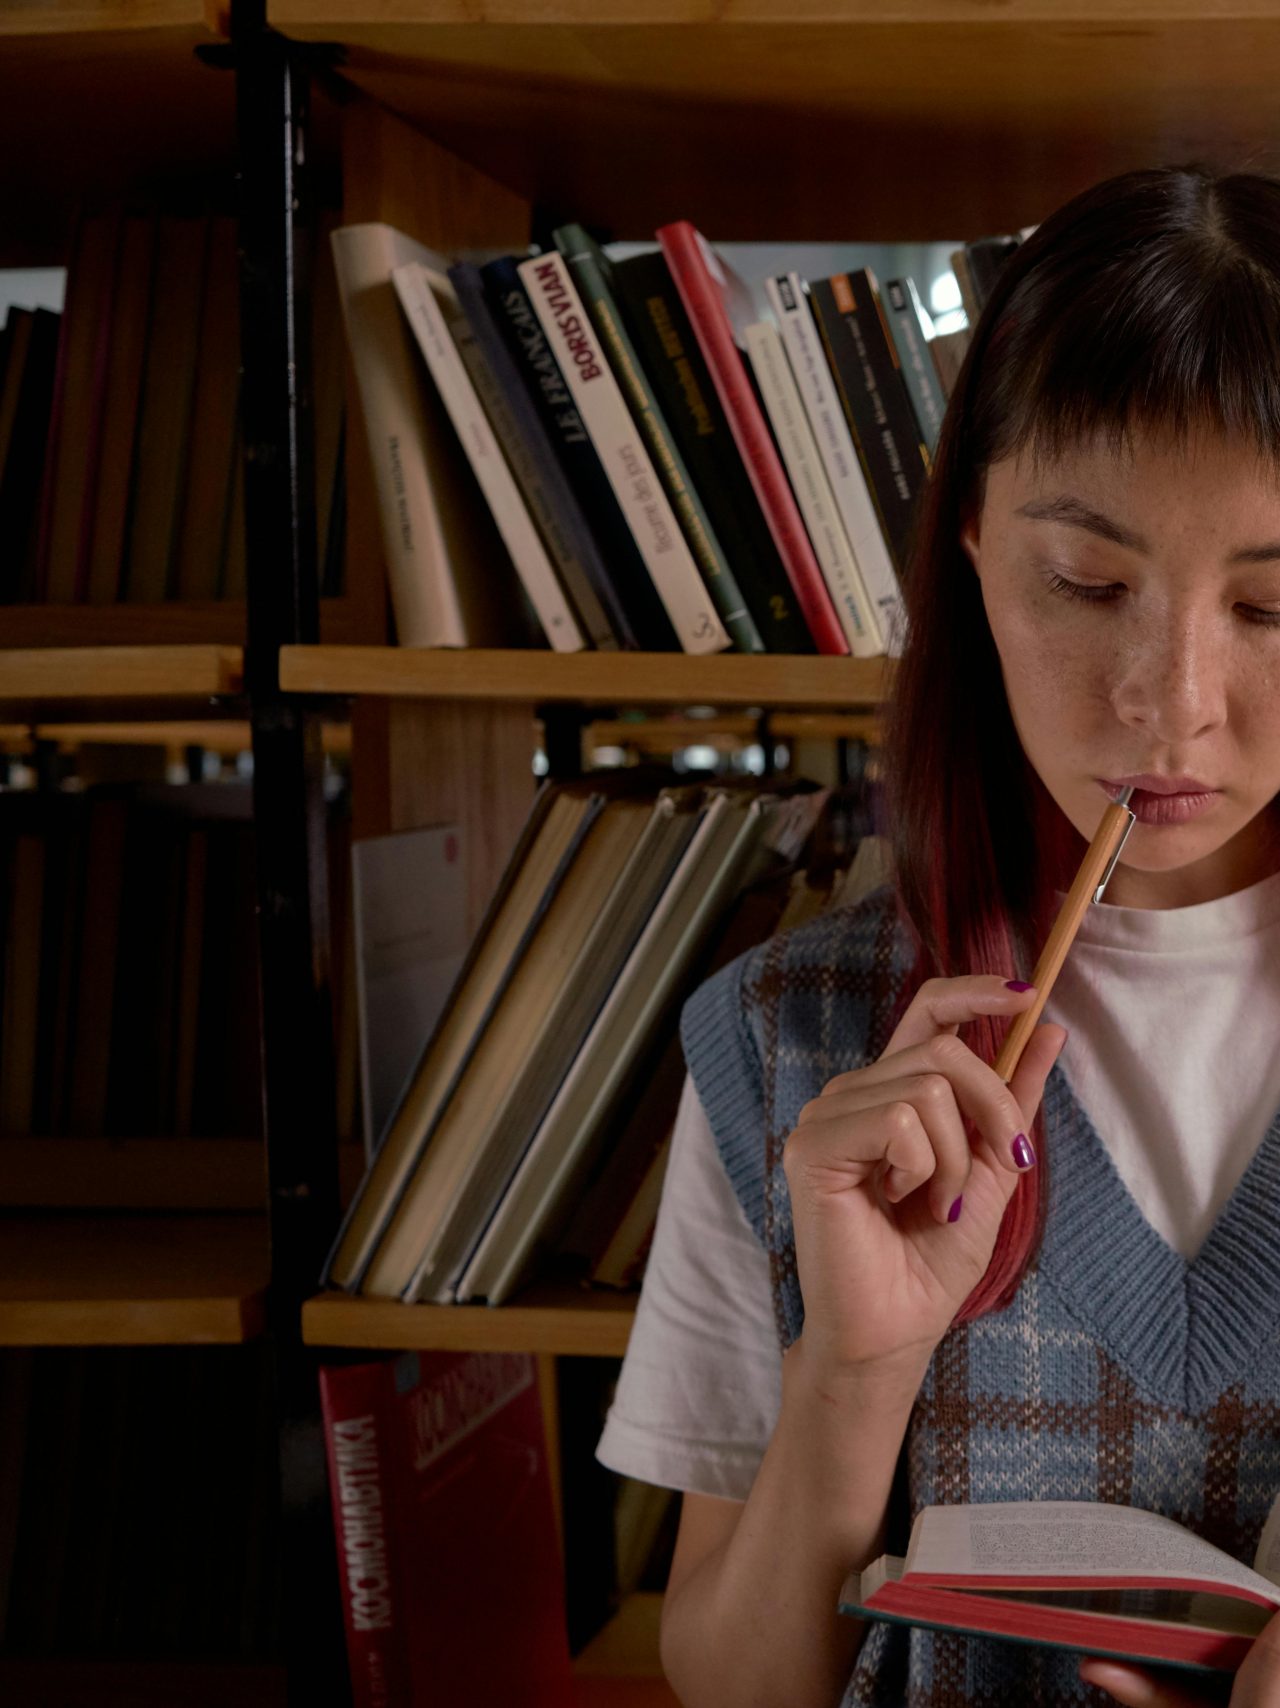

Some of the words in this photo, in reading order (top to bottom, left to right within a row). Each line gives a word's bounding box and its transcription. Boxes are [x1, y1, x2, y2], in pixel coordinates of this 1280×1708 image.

[532, 259, 573, 317] VIAN
[495, 284, 578, 412] FRANÇAIS
[556, 314, 603, 384] BORIS
[552, 405, 589, 449] LE
[769, 594, 789, 620] 2
[334, 1415, 393, 1631] КОСМОНАВТИКА
